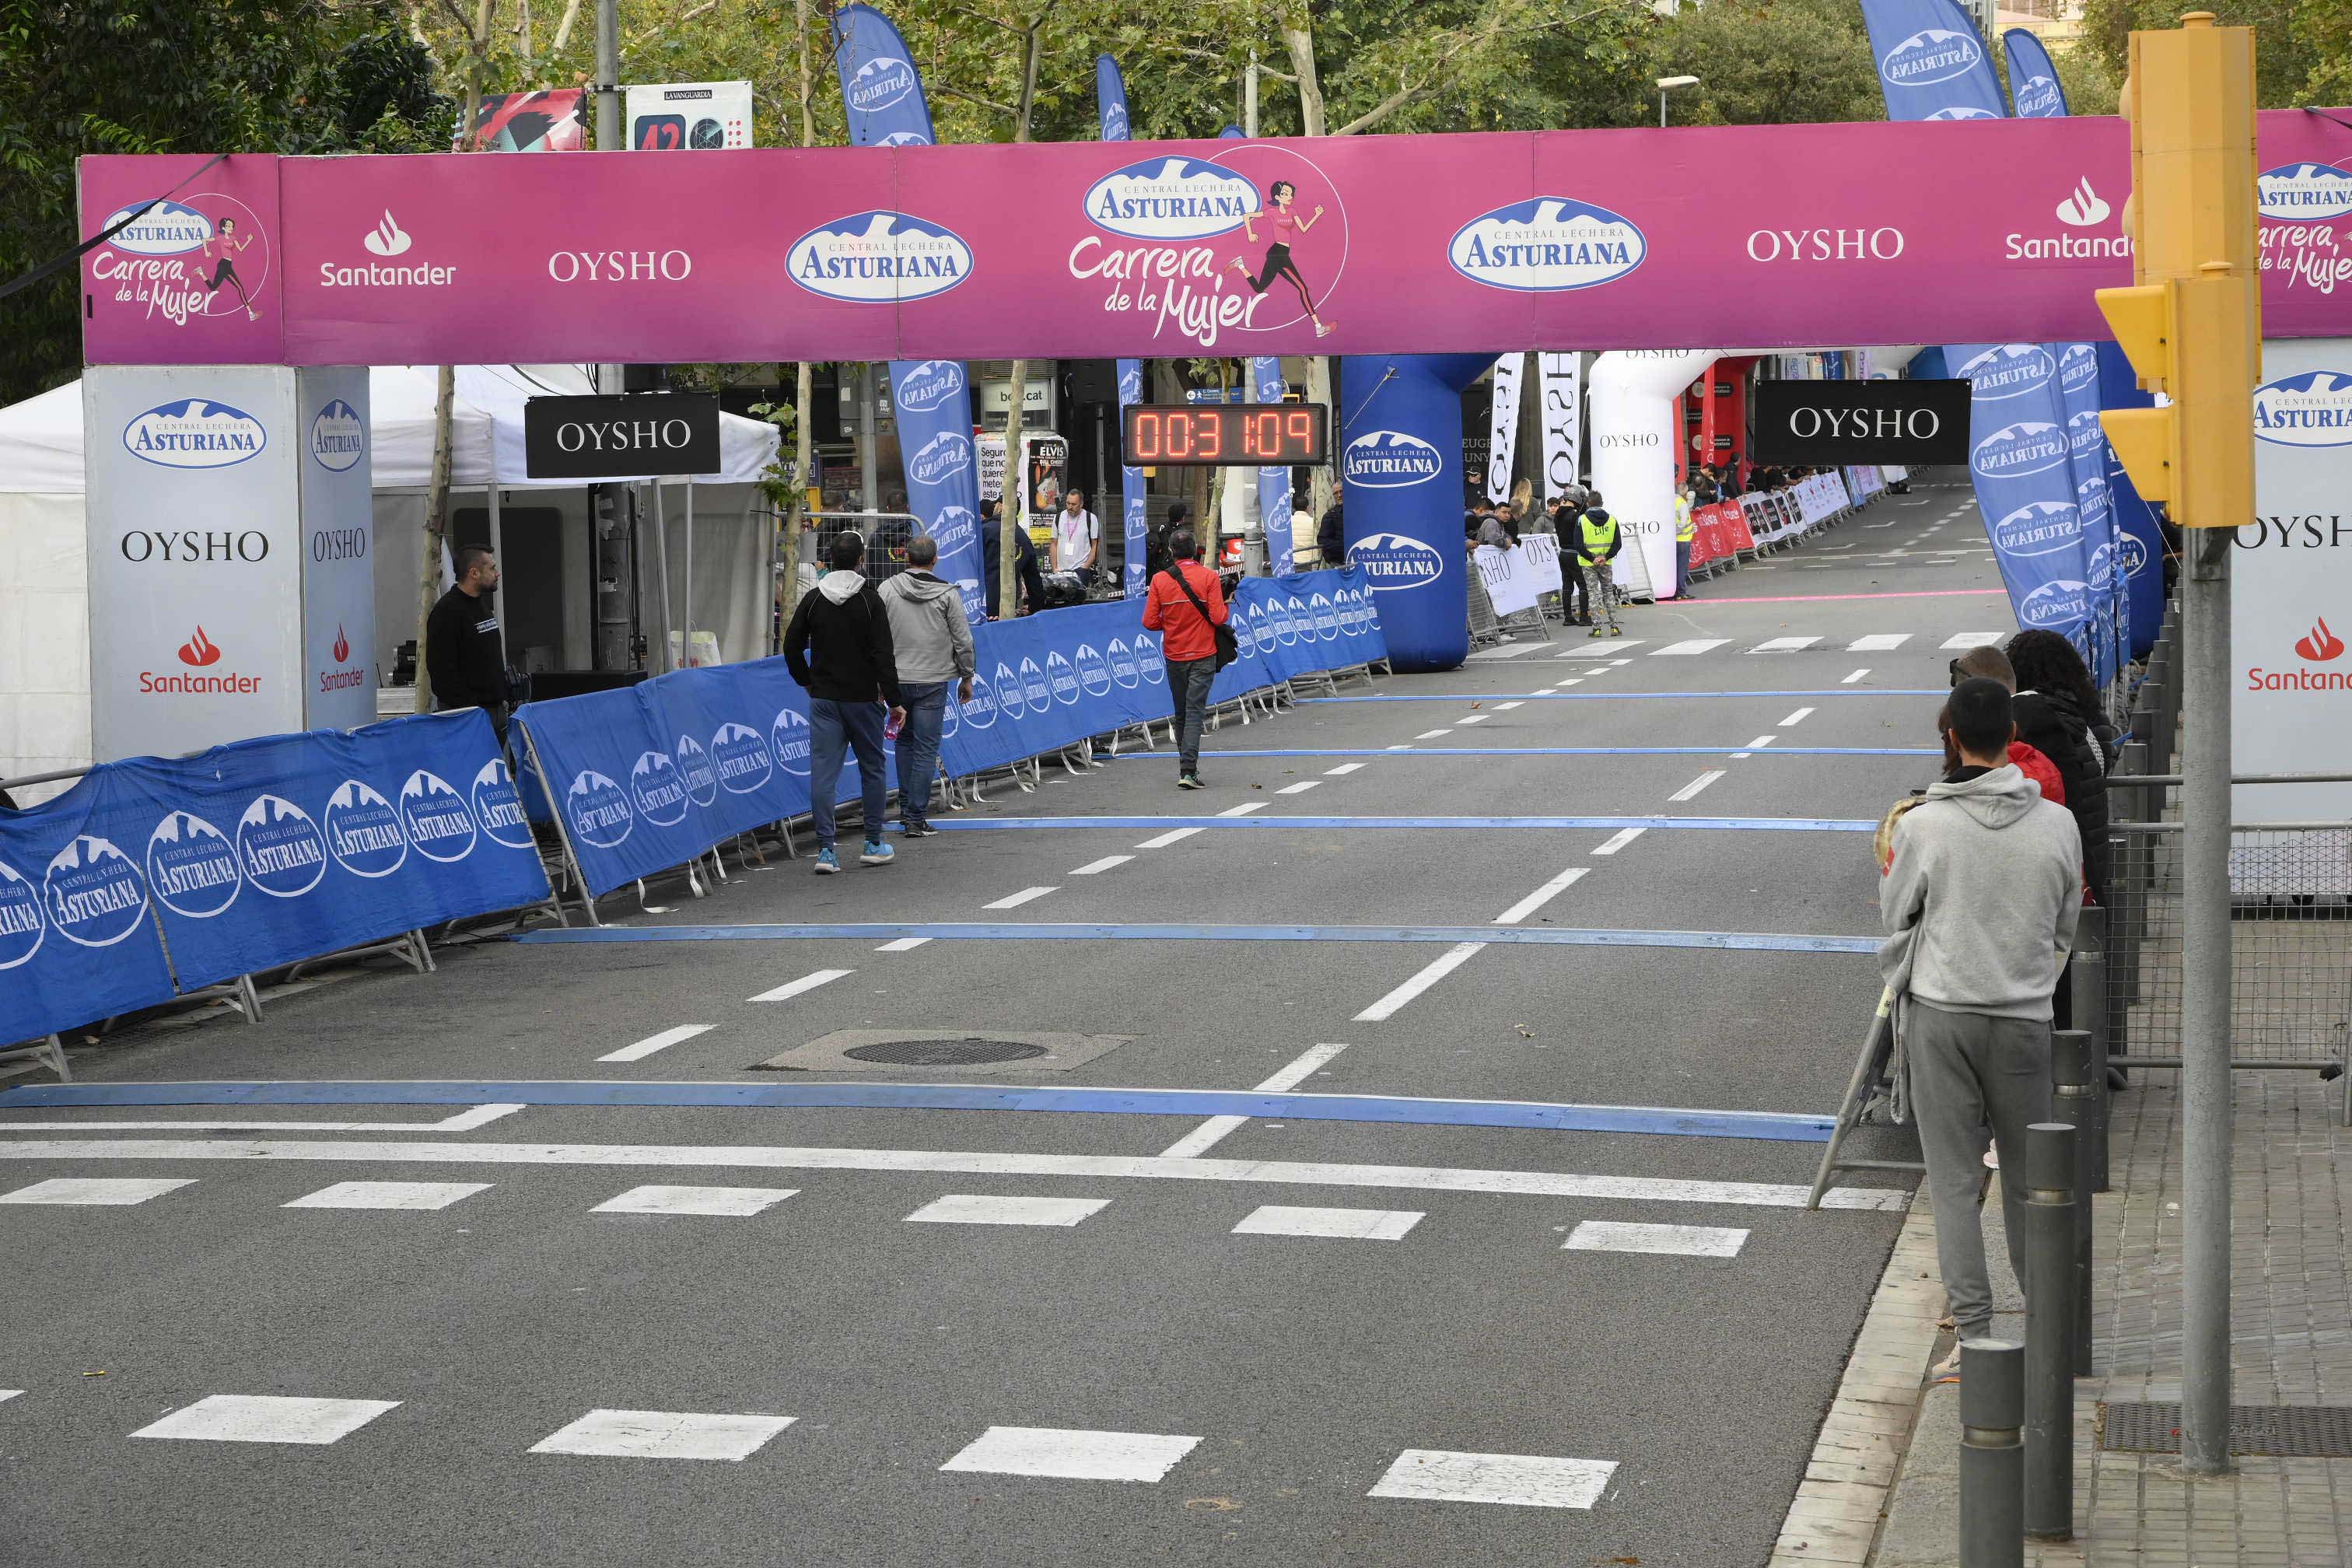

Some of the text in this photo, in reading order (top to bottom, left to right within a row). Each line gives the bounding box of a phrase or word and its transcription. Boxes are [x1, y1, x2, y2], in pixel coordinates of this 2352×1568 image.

[1124, 184, 1242, 194] CENTRAL LECHERA
[1097, 187, 1246, 219] ASTURIANA
[828, 242, 953, 253] CENTRAL LECHERA
[1493, 228, 1626, 240] CENTRAL LECHERA
[1746, 227, 1905, 262] OYSHO
[800, 245, 959, 279] ASTURIANA
[1069, 236, 1214, 280] Carrera
[1463, 233, 1632, 268] ASTURIANA
[2277, 248, 2291, 270] la
[93, 251, 184, 281] Carrera
[320, 261, 457, 287] Santander
[548, 249, 691, 282] OYSHO
[2287, 243, 2352, 294] Muje
[115, 281, 149, 303] de la
[146, 276, 219, 326] Mujer
[1104, 280, 1157, 312] de la
[1153, 274, 1269, 347] Mujer
[2276, 397, 2328, 406] CENTRAL
[156, 422, 251, 431] CENTRAL LECHERA
[556, 418, 691, 453] OYSHO
[1136, 412, 1311, 456] 00:31:09
[1789, 407, 1941, 439] OYSHO
[135, 425, 257, 452] ASTURIANA
[315, 429, 361, 454] ASTURIANA
[1040, 446, 1064, 457] ELVIS
[1600, 432, 1658, 449] OYSHO
[982, 460, 995, 470] que
[1346, 454, 1434, 476] ASTURIANA
[983, 490, 998, 499] este
[121, 530, 269, 562] OYSHO
[313, 527, 366, 562] OYSHO
[138, 670, 262, 695] Santander
[320, 666, 365, 694] Santander
[413, 798, 460, 814] CENTRAL LECHERA
[486, 789, 512, 800] CENTRAL
[340, 809, 393, 825] CENTRAL LECHERA
[406, 807, 473, 842] ASTURIANA
[253, 823, 310, 844] CENTRAL LECHERA
[333, 819, 404, 857] ASTURIANA
[165, 849, 194, 861] CENTRAL
[245, 838, 324, 877] ASTURIANA
[156, 856, 237, 897] ASTURIANA
